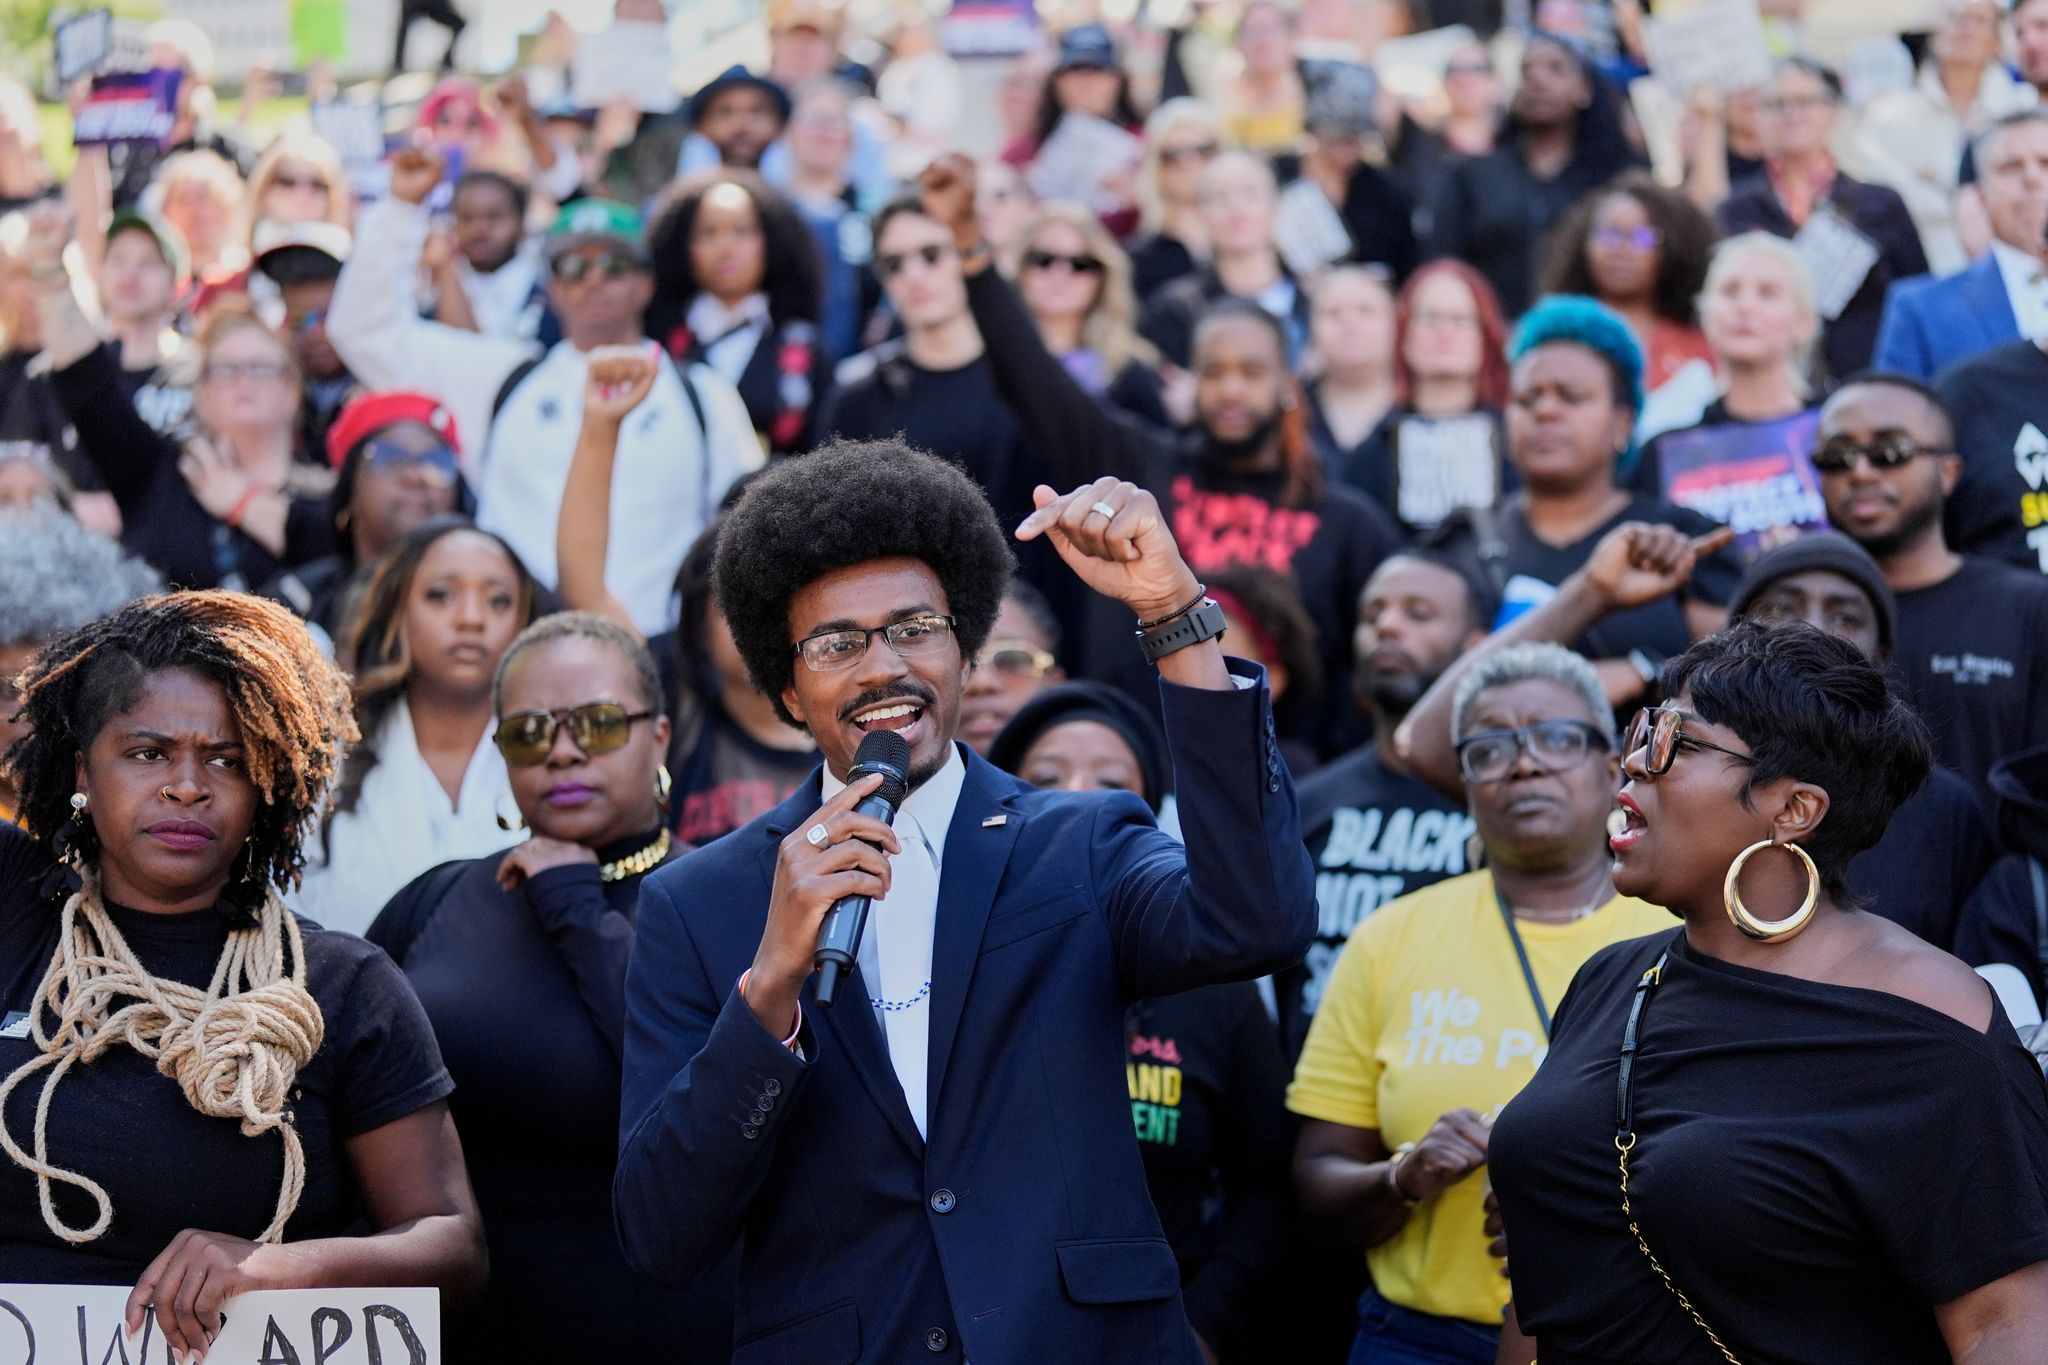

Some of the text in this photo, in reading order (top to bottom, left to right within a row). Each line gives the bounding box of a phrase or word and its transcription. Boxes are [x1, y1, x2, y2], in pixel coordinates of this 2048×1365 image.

[1320, 807, 1477, 875] BLACK
[1411, 985, 1482, 1029] We
[1403, 1026, 1485, 1068] The
